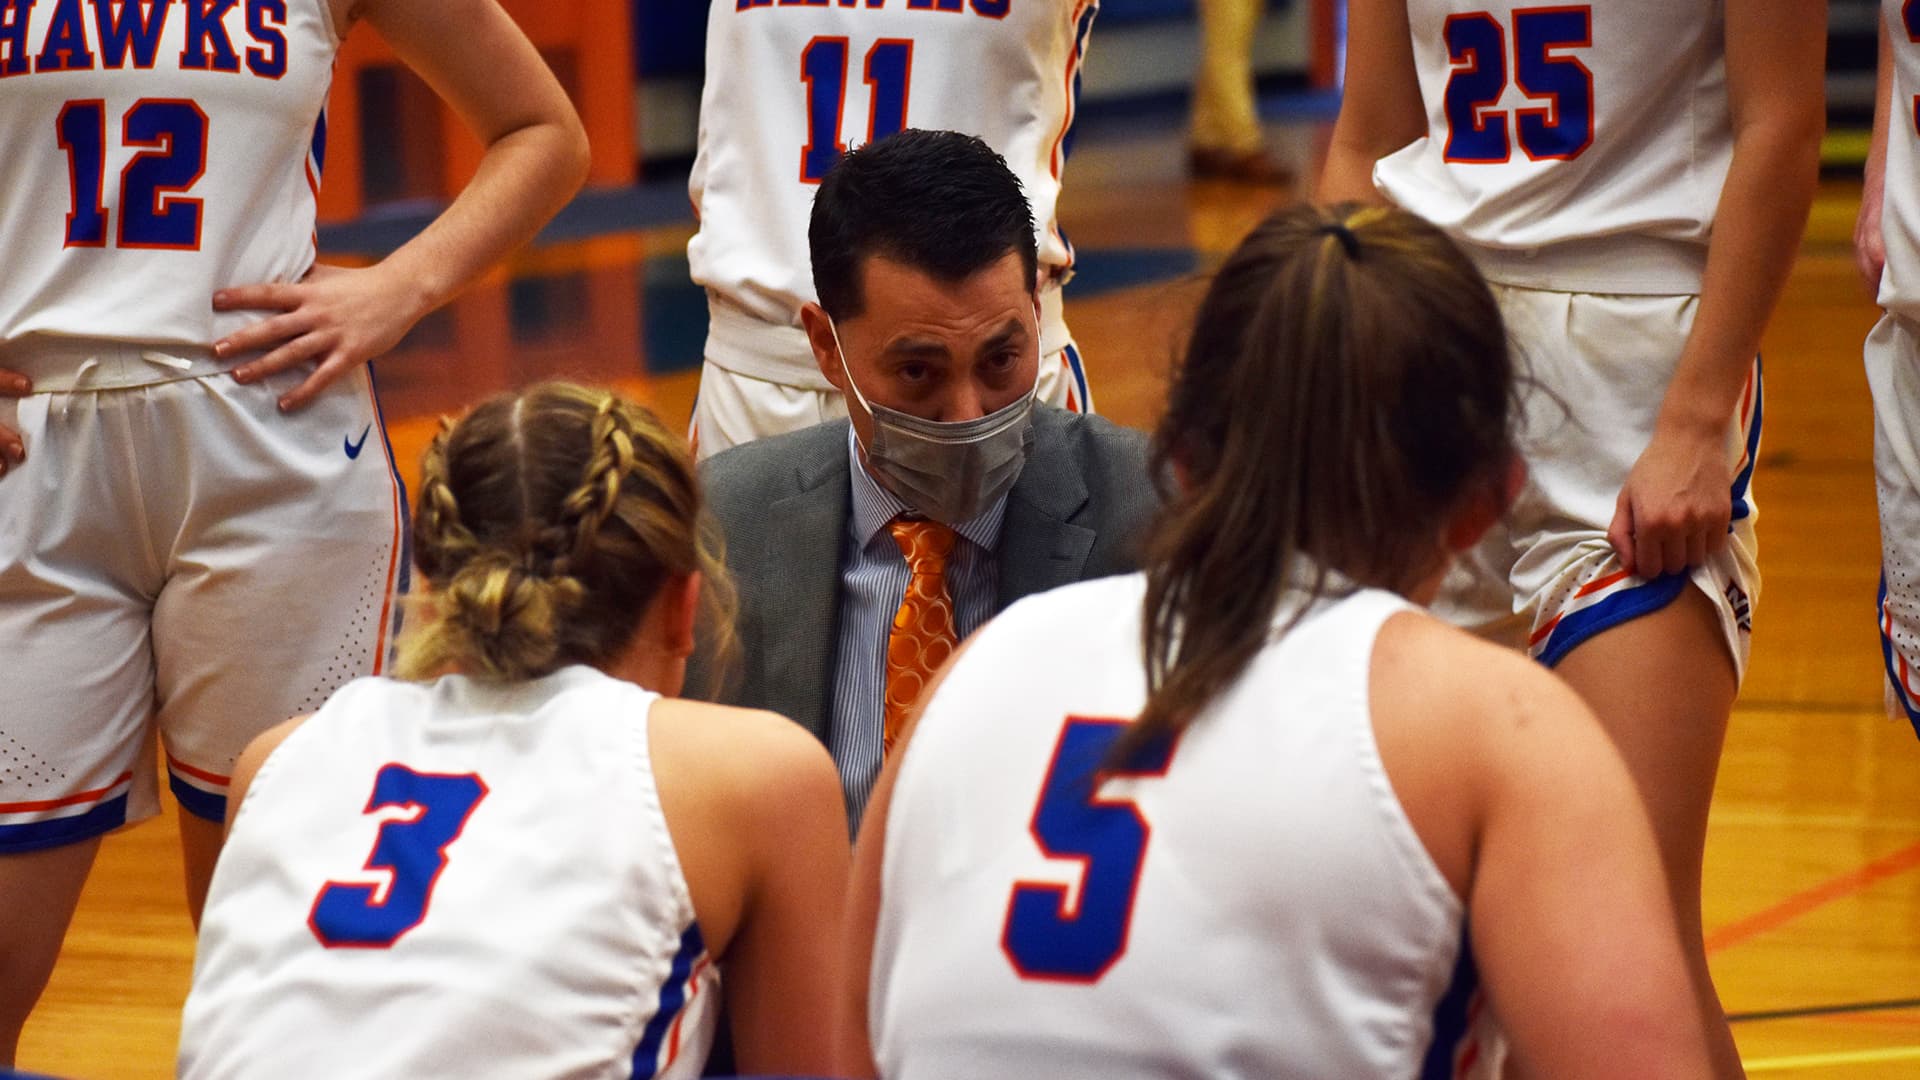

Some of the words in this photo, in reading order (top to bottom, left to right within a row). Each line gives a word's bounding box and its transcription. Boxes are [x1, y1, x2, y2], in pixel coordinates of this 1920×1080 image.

[0, 0, 288, 80] HAWKS
[799, 34, 914, 184] 11
[1443, 5, 1594, 164] 25
[56, 98, 209, 251] 12
[307, 762, 490, 949] 3
[1000, 715, 1183, 985] 5
